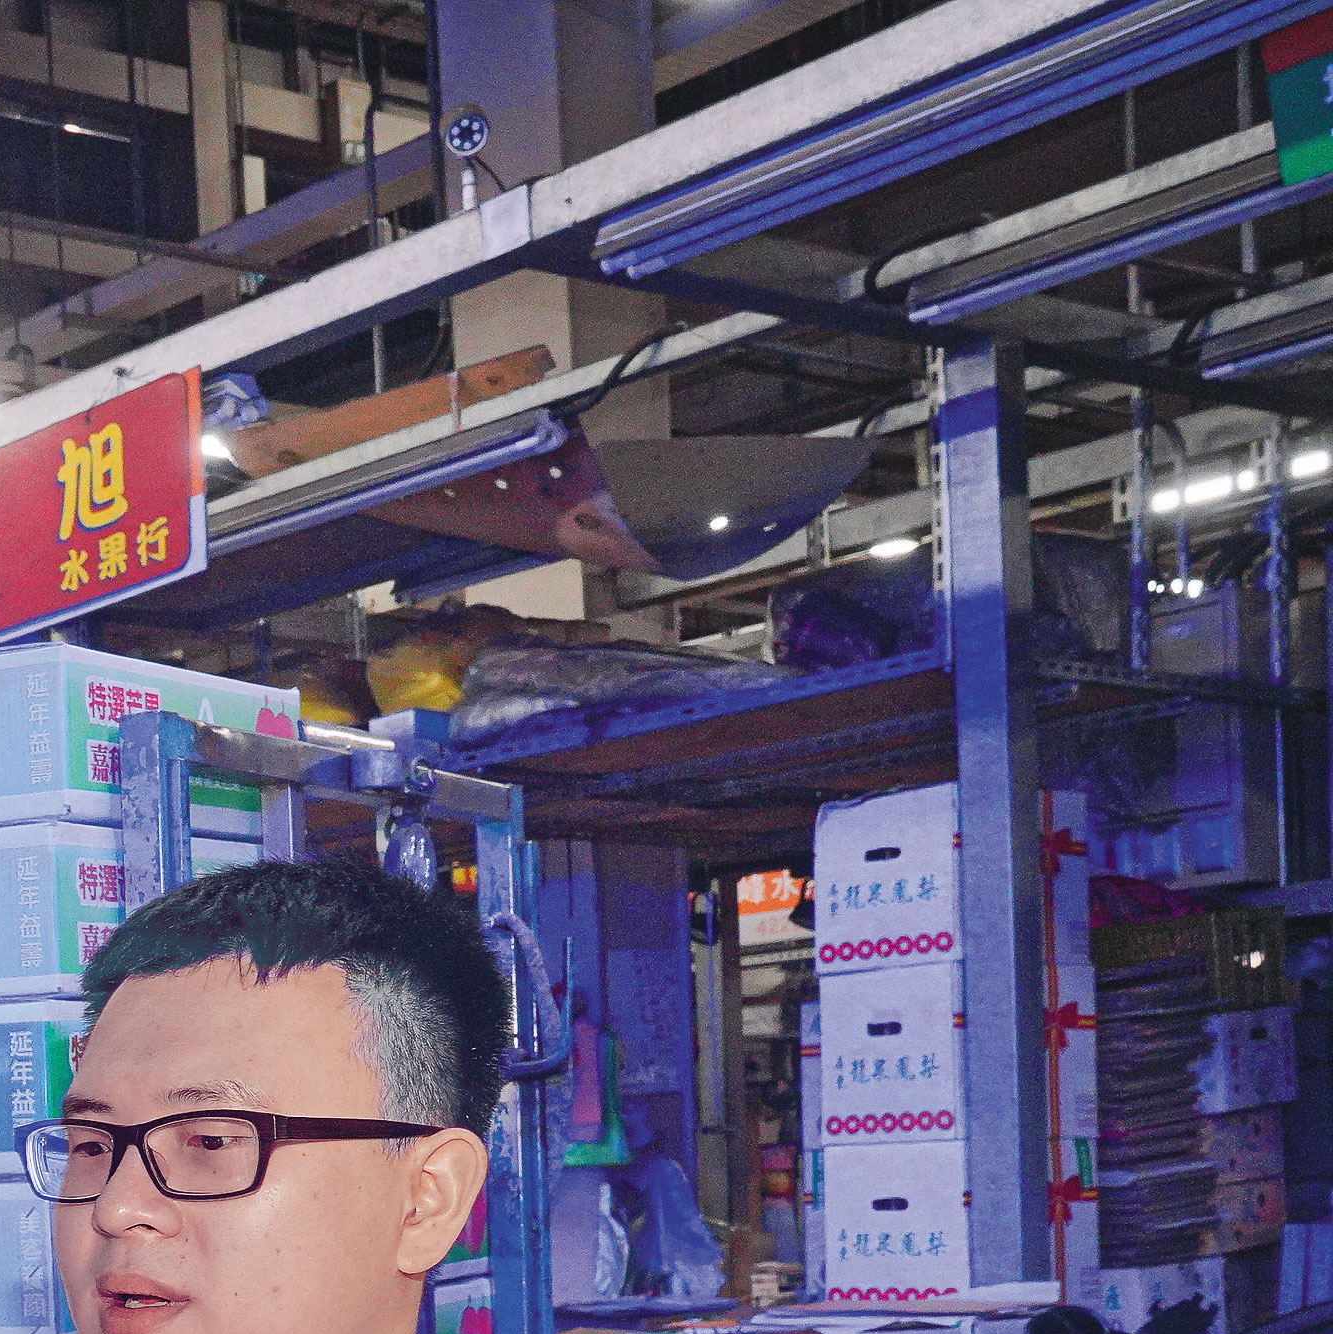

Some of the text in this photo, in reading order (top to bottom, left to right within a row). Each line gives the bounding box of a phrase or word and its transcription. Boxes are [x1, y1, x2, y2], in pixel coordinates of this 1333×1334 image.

[56, 422, 130, 542] 旭
[60, 516, 170, 592] 水果行
[25, 671, 57, 787] 延年益壽
[16, 855, 44, 969] 延年益壽
[9, 1030, 35, 1128] 延年益
